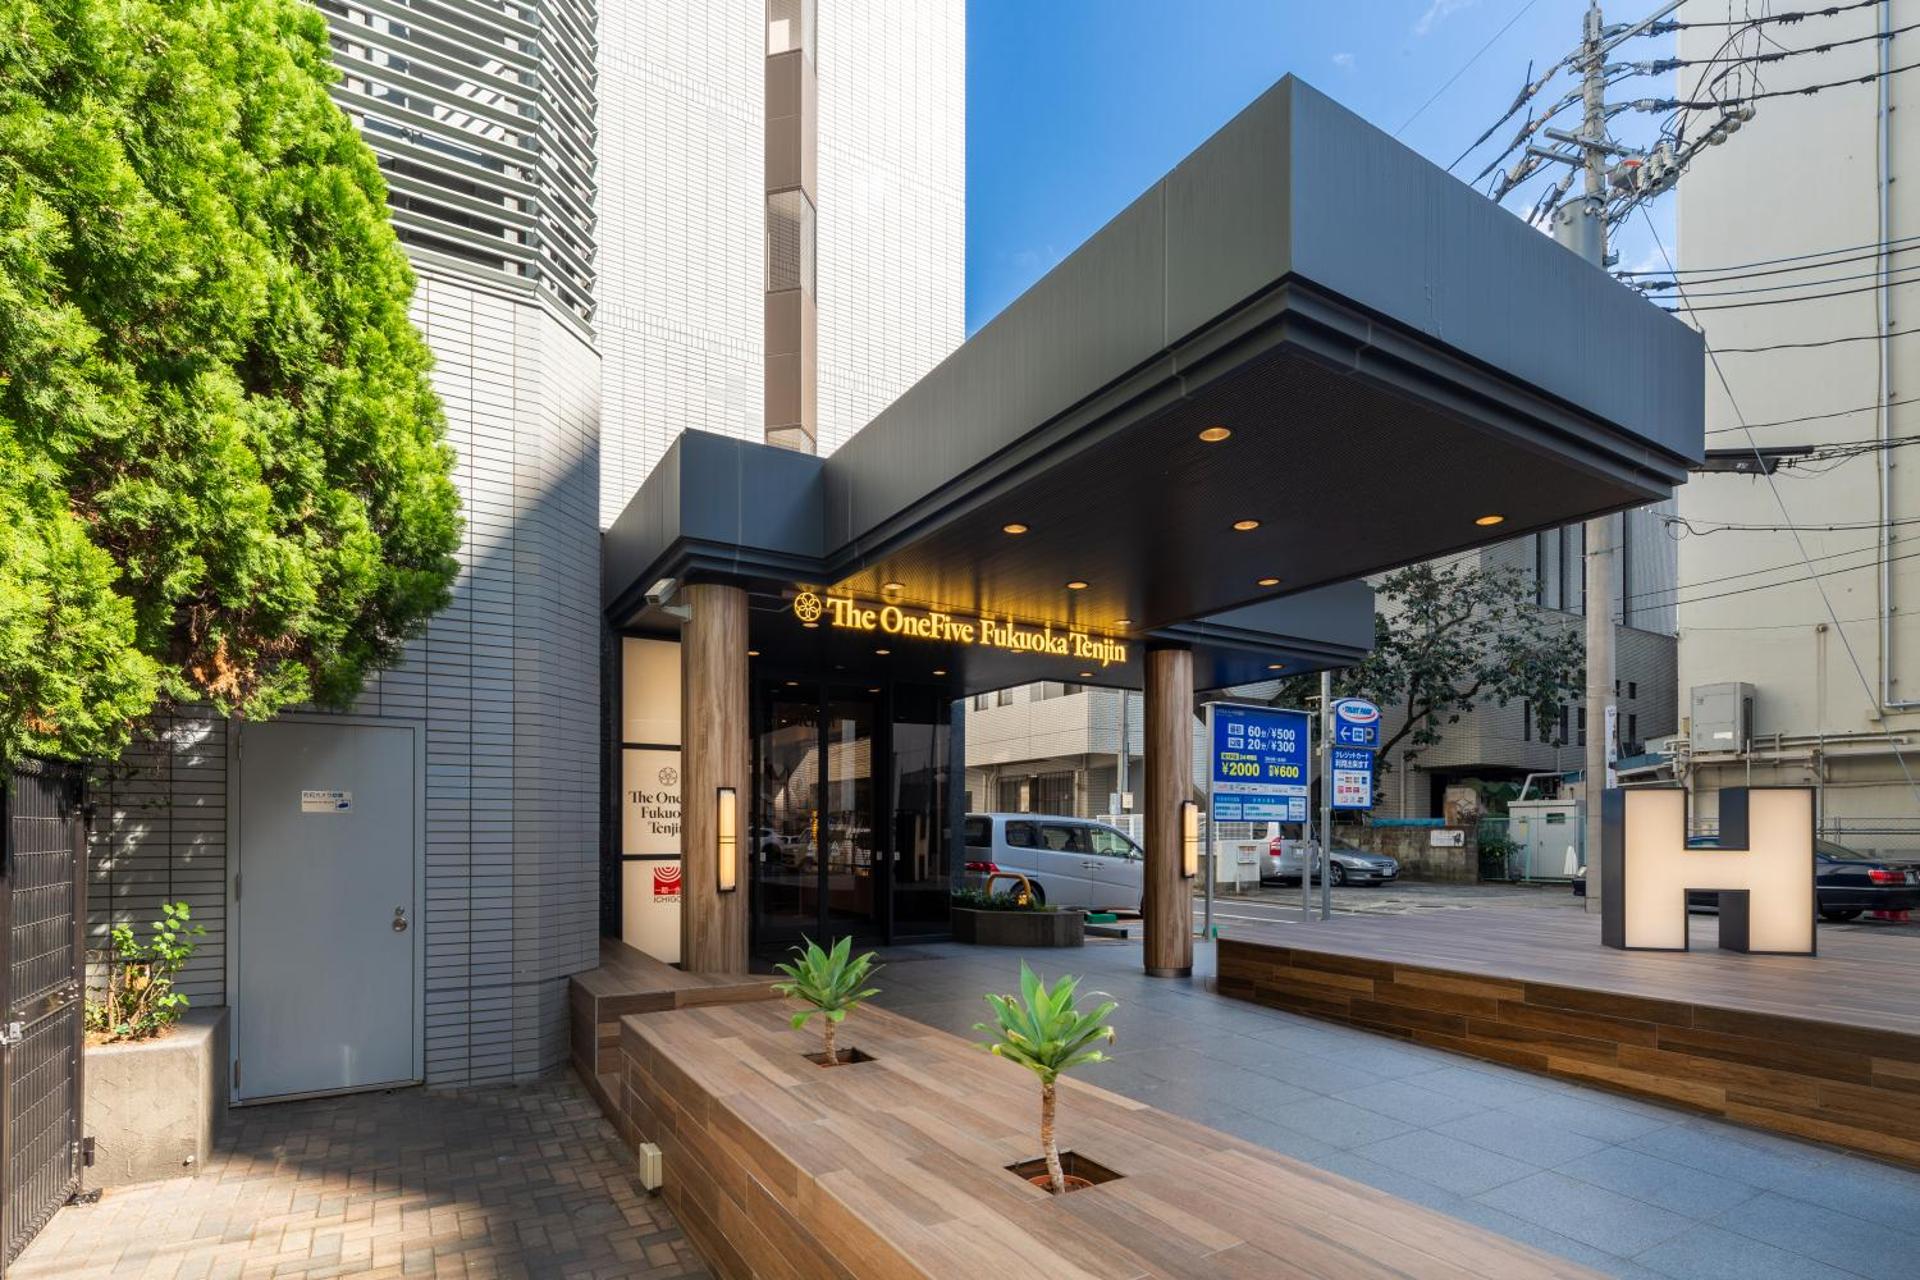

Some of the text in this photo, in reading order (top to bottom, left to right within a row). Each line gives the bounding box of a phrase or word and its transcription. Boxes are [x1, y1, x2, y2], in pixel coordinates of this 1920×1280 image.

[826, 597, 1126, 667] The OneFive Fukuoka Tenjin
[1222, 761, 1260, 776] ¥2000
[628, 790, 653, 803] The
[1622, 786, 1816, 956] H
